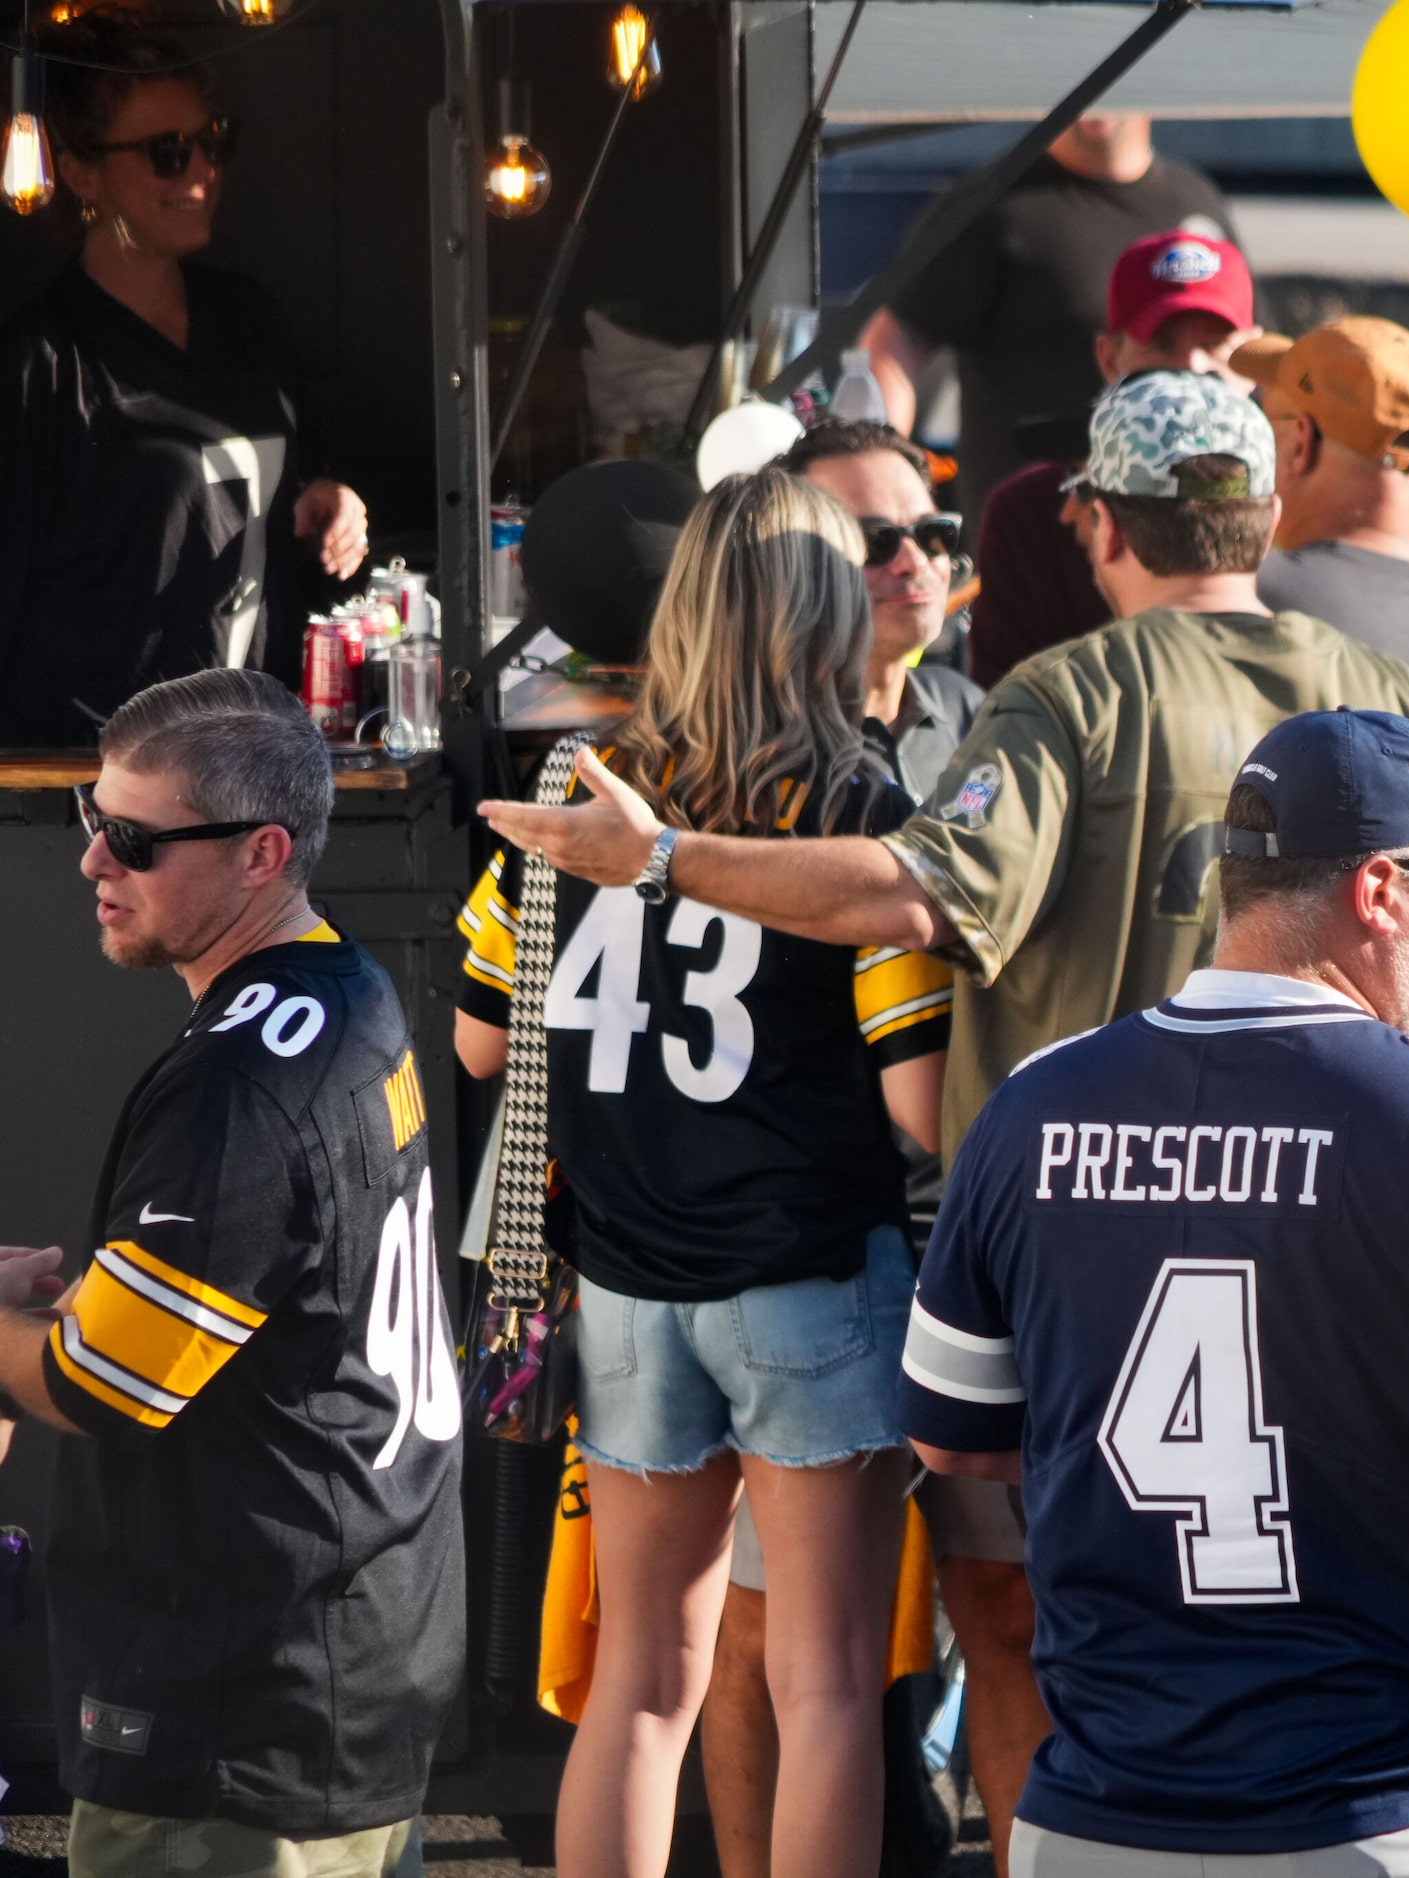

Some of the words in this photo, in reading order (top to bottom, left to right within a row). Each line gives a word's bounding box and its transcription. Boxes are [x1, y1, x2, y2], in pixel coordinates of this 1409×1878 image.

[207, 983, 326, 1058] 90
[544, 886, 762, 1103] 43
[1036, 1122, 1334, 1206] PRESCOTT
[366, 1166, 462, 1470] 90
[1096, 1258, 1301, 1605] 4
